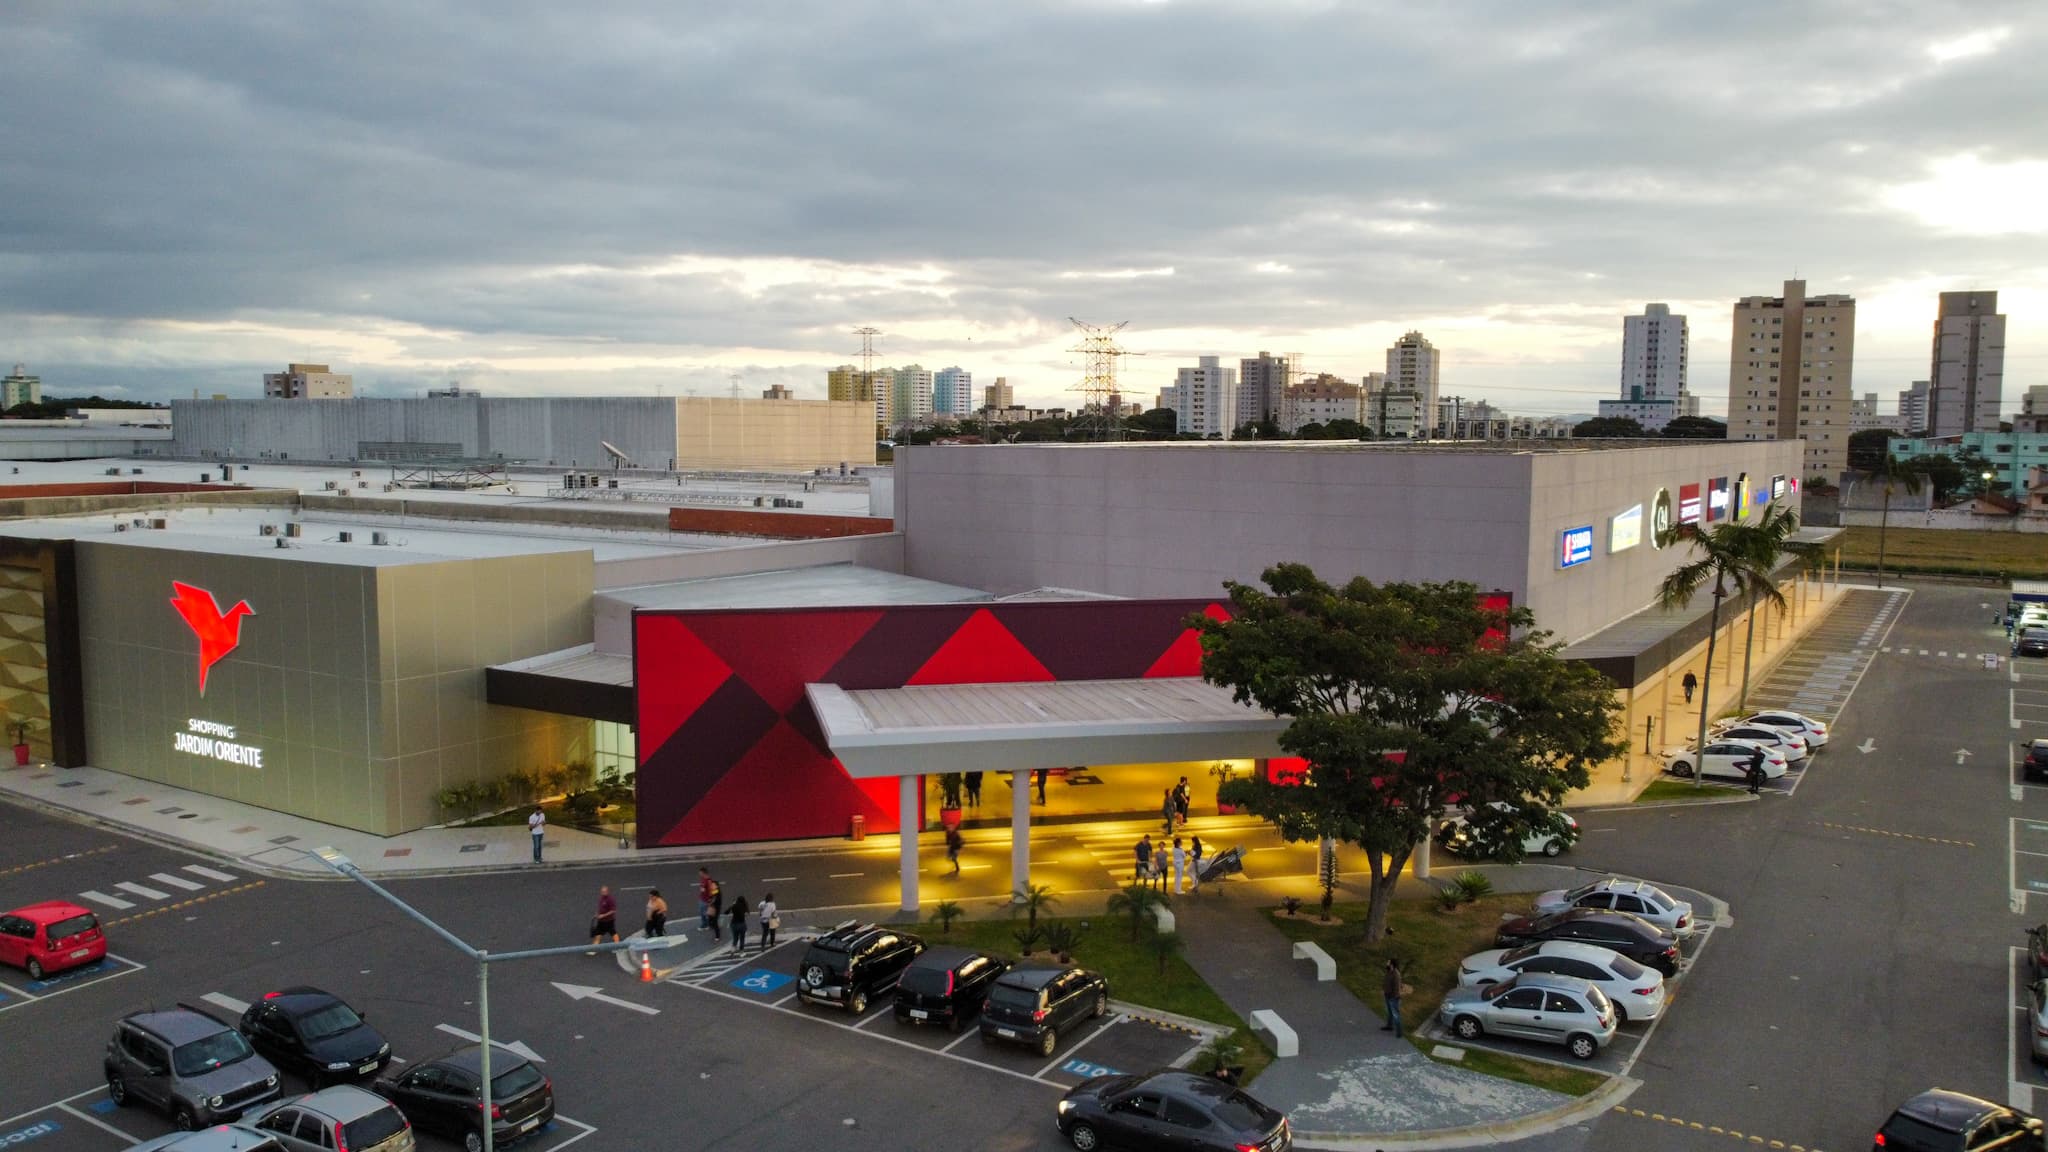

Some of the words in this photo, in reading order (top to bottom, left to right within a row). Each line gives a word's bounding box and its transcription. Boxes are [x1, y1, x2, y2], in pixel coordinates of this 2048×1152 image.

[188, 718, 235, 739] SHOPPING
[174, 732, 214, 757] JARDIM
[215, 740, 263, 768] ORIENTE
[1063, 1060, 1120, 1077] IDO
